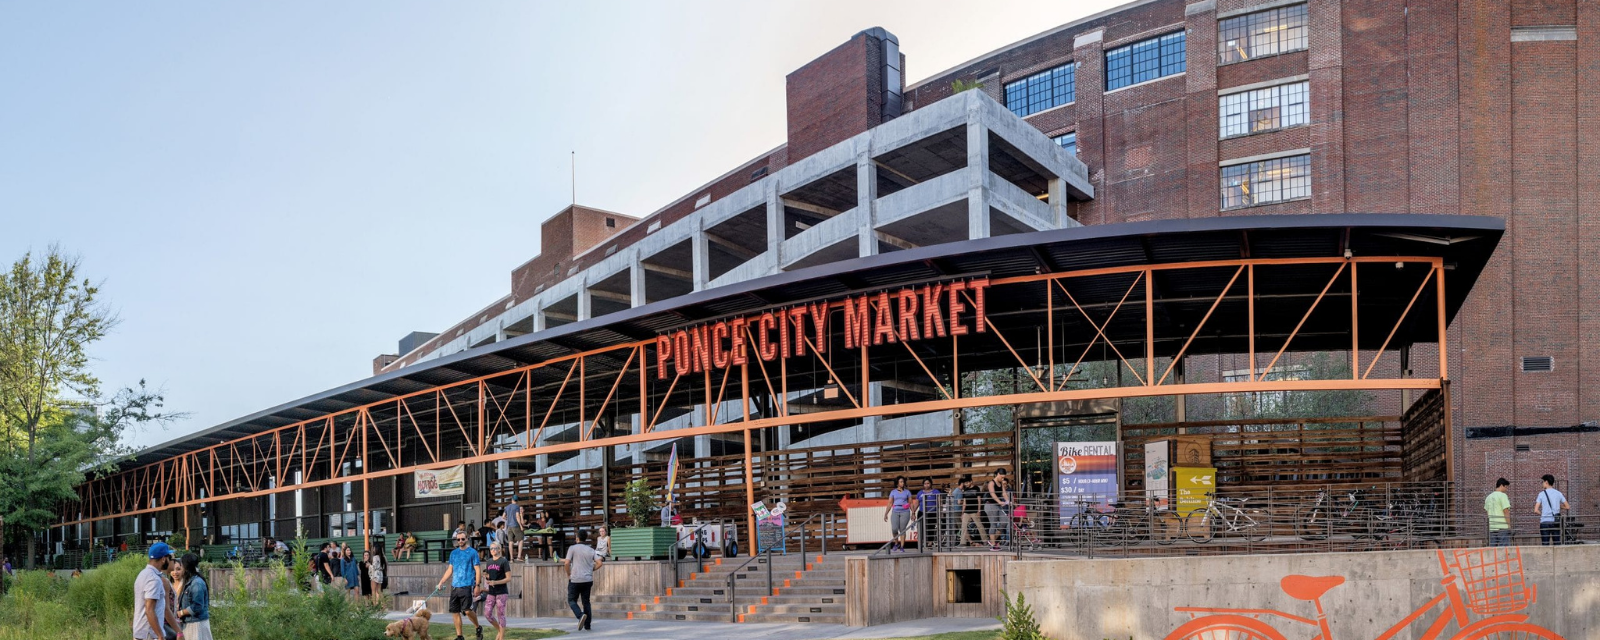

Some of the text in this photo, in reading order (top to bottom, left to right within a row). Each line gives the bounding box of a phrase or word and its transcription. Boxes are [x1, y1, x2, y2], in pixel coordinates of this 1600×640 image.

[657, 279, 990, 380] PONCE CITY MARKET
[1060, 445, 1113, 457] Bike RENTAL
